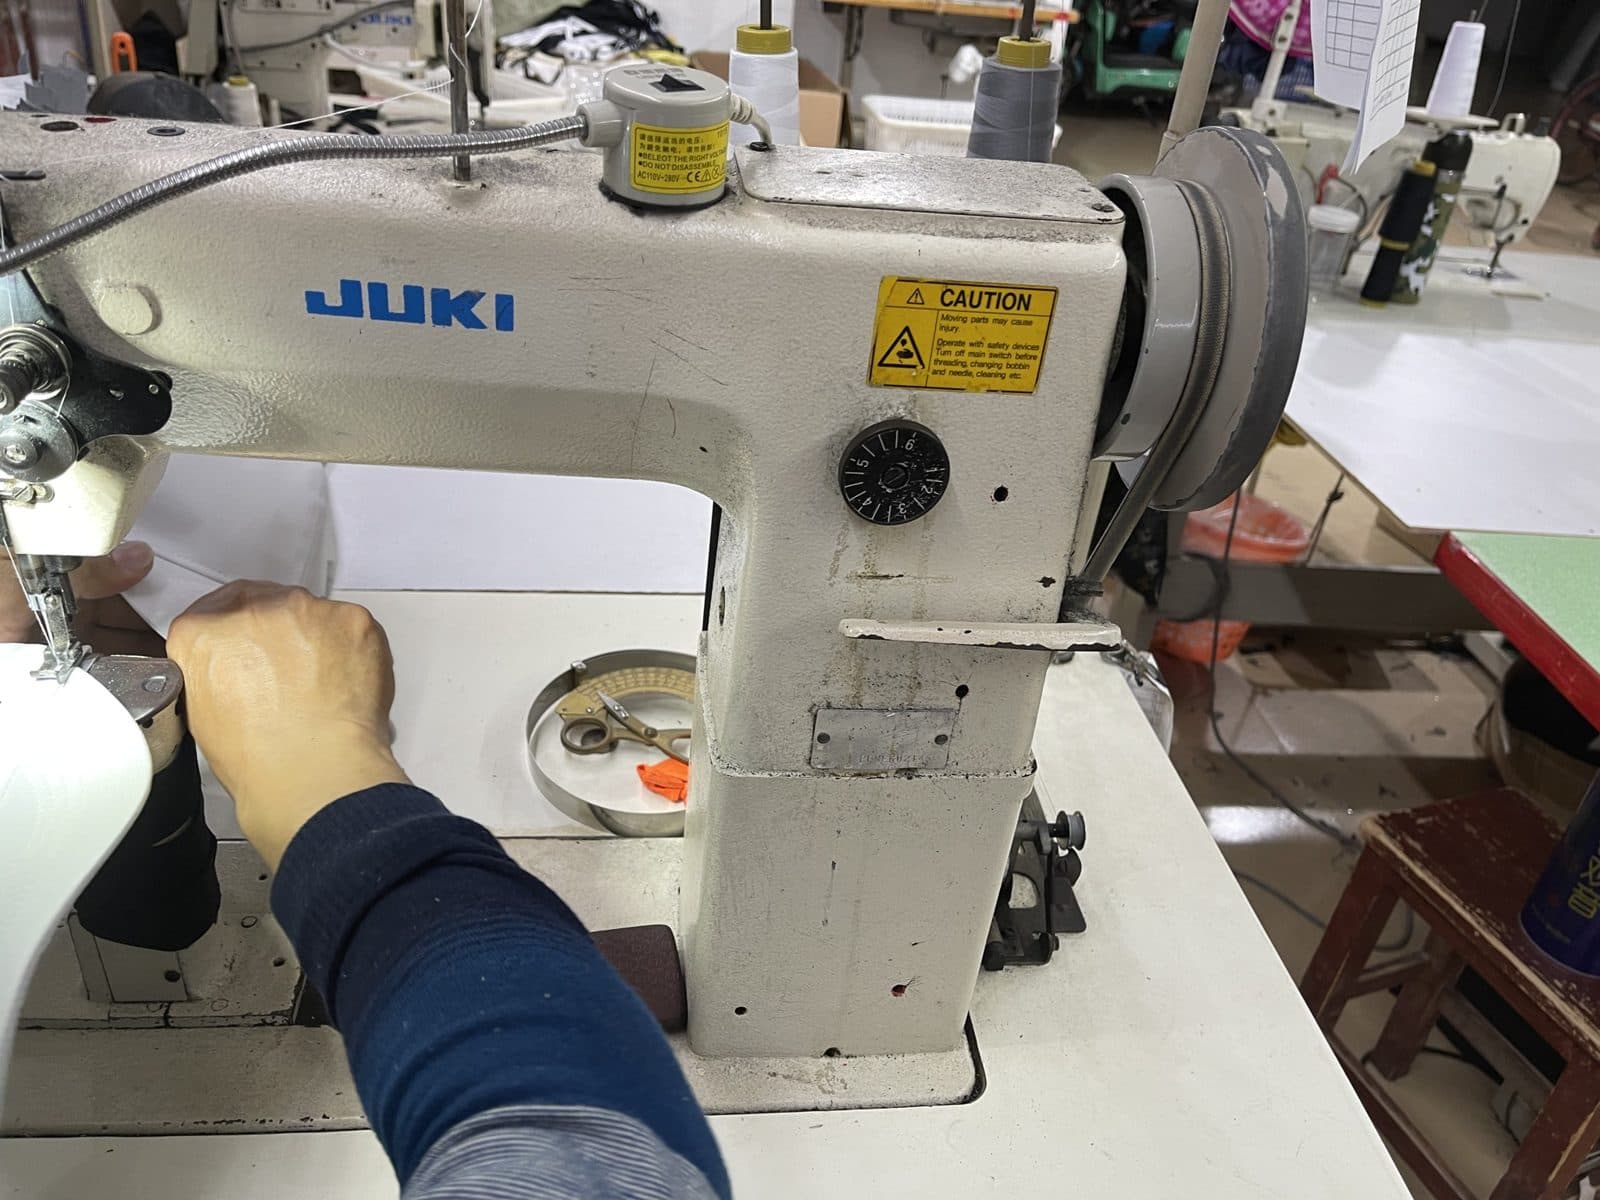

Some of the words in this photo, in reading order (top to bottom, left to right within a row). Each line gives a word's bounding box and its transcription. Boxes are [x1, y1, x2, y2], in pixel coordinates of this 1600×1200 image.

[674, 155, 688, 163] THE
[689, 154, 708, 162] RIGHT
[654, 162, 670, 170] NOT
[940, 288, 1032, 311] CAUTION
[305, 279, 515, 332] JUKI
[941, 314, 968, 323] Moving
[970, 316, 989, 324] parts
[992, 318, 1008, 326] may
[937, 338, 966, 347] Operate
[969, 340, 985, 348] with
[987, 342, 1010, 351] safety
[1012, 343, 1040, 351] devices
[936, 348, 952, 357] Turn
[1015, 353, 1038, 361] before
[970, 360, 1003, 370] changing
[1006, 362, 1030, 370] bobbin
[976, 371, 1007, 380] cleaning
[905, 439, 915, 450] 6
[856, 459, 870, 468] 5
[921, 484, 933, 494] 2
[862, 496, 873, 506] 4
[898, 503, 907, 514] 3
